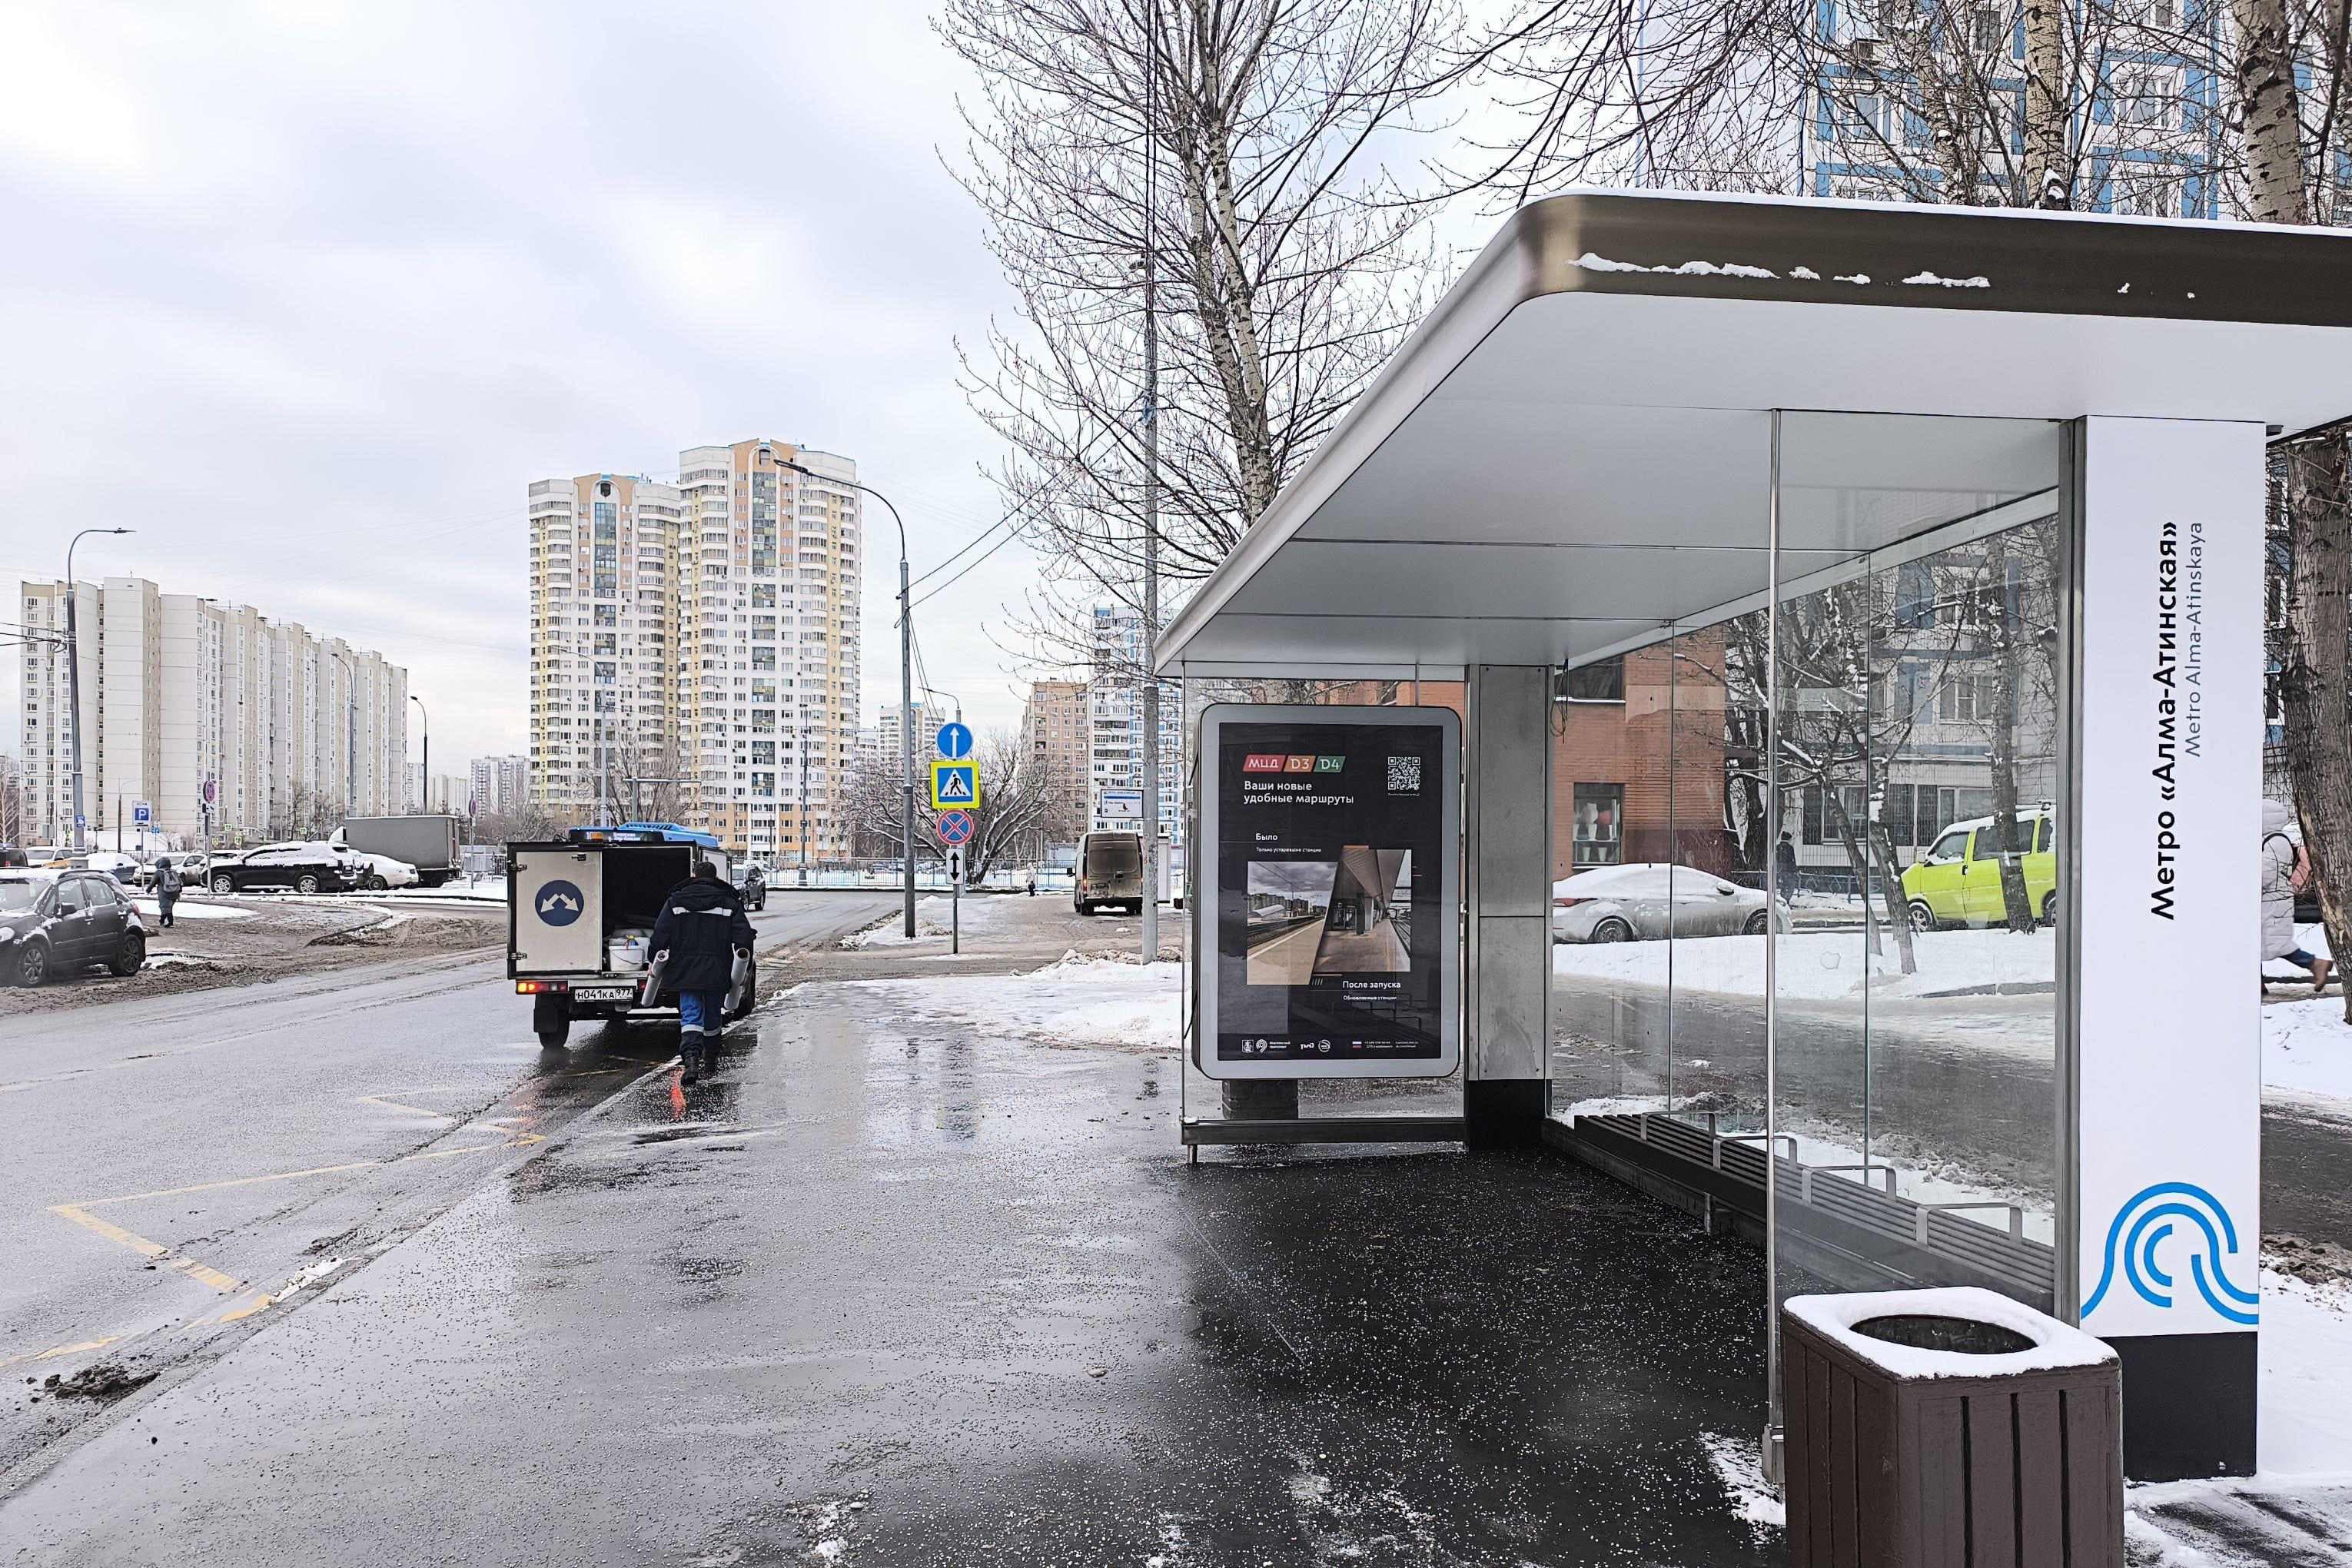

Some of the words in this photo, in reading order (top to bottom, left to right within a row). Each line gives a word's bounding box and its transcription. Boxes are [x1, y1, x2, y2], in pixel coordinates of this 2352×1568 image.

[2184, 522, 2206, 686] Alma-Atinskaya
[2151, 521, 2178, 801] «Алма-Атинская»
[2184, 691, 2202, 757] Metro
[1248, 757, 1279, 769] МЦД
[1290, 757, 1310, 769] D3
[1320, 758, 1340, 770] D4
[1244, 780, 1274, 791] Ваши
[1277, 782, 1313, 791] новые
[1243, 792, 1293, 805] удобные
[1295, 795, 1354, 806] маршруты
[1255, 832, 1278, 841] Было
[2151, 811, 2181, 921] Метро
[1342, 980, 1368, 989] После
[1369, 982, 1401, 990] запуска
